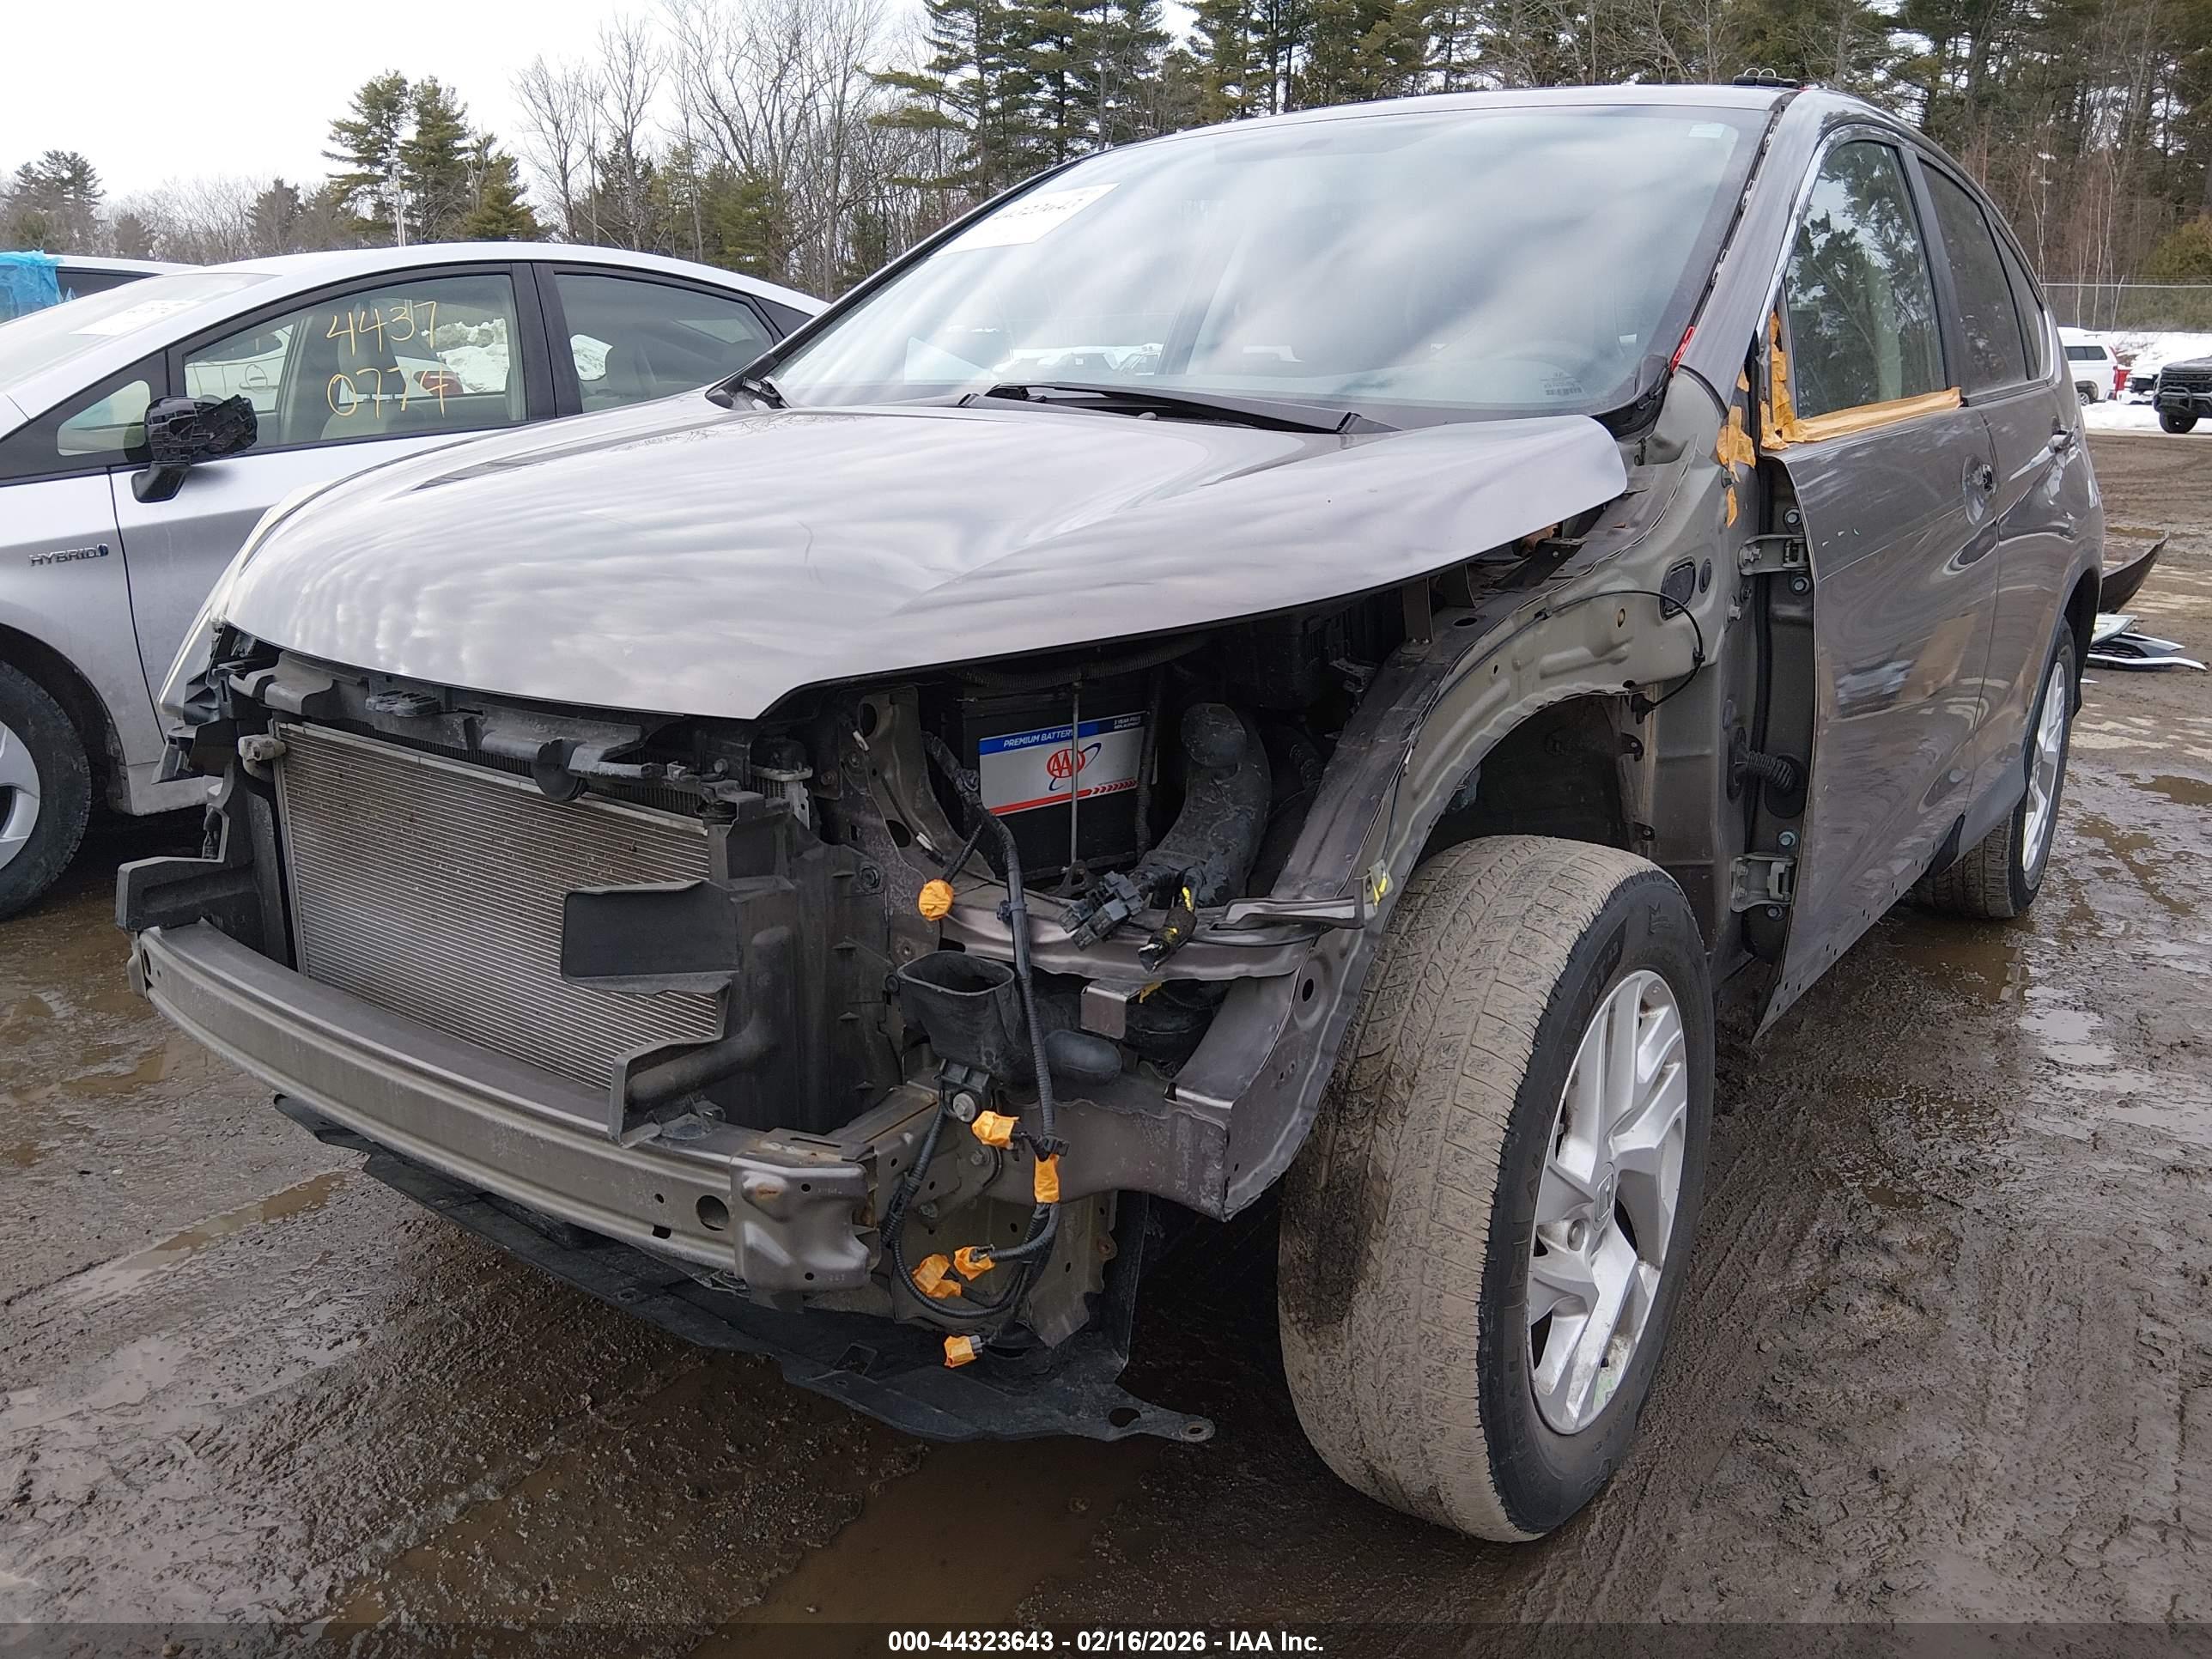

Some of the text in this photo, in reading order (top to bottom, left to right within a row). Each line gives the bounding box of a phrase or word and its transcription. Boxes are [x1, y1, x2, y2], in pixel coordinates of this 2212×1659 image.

[325, 301, 437, 356] 4437
[326, 363, 449, 419] 0774
[28, 547, 98, 567] HYBRID
[1003, 734, 1041, 749] PREMIUM
